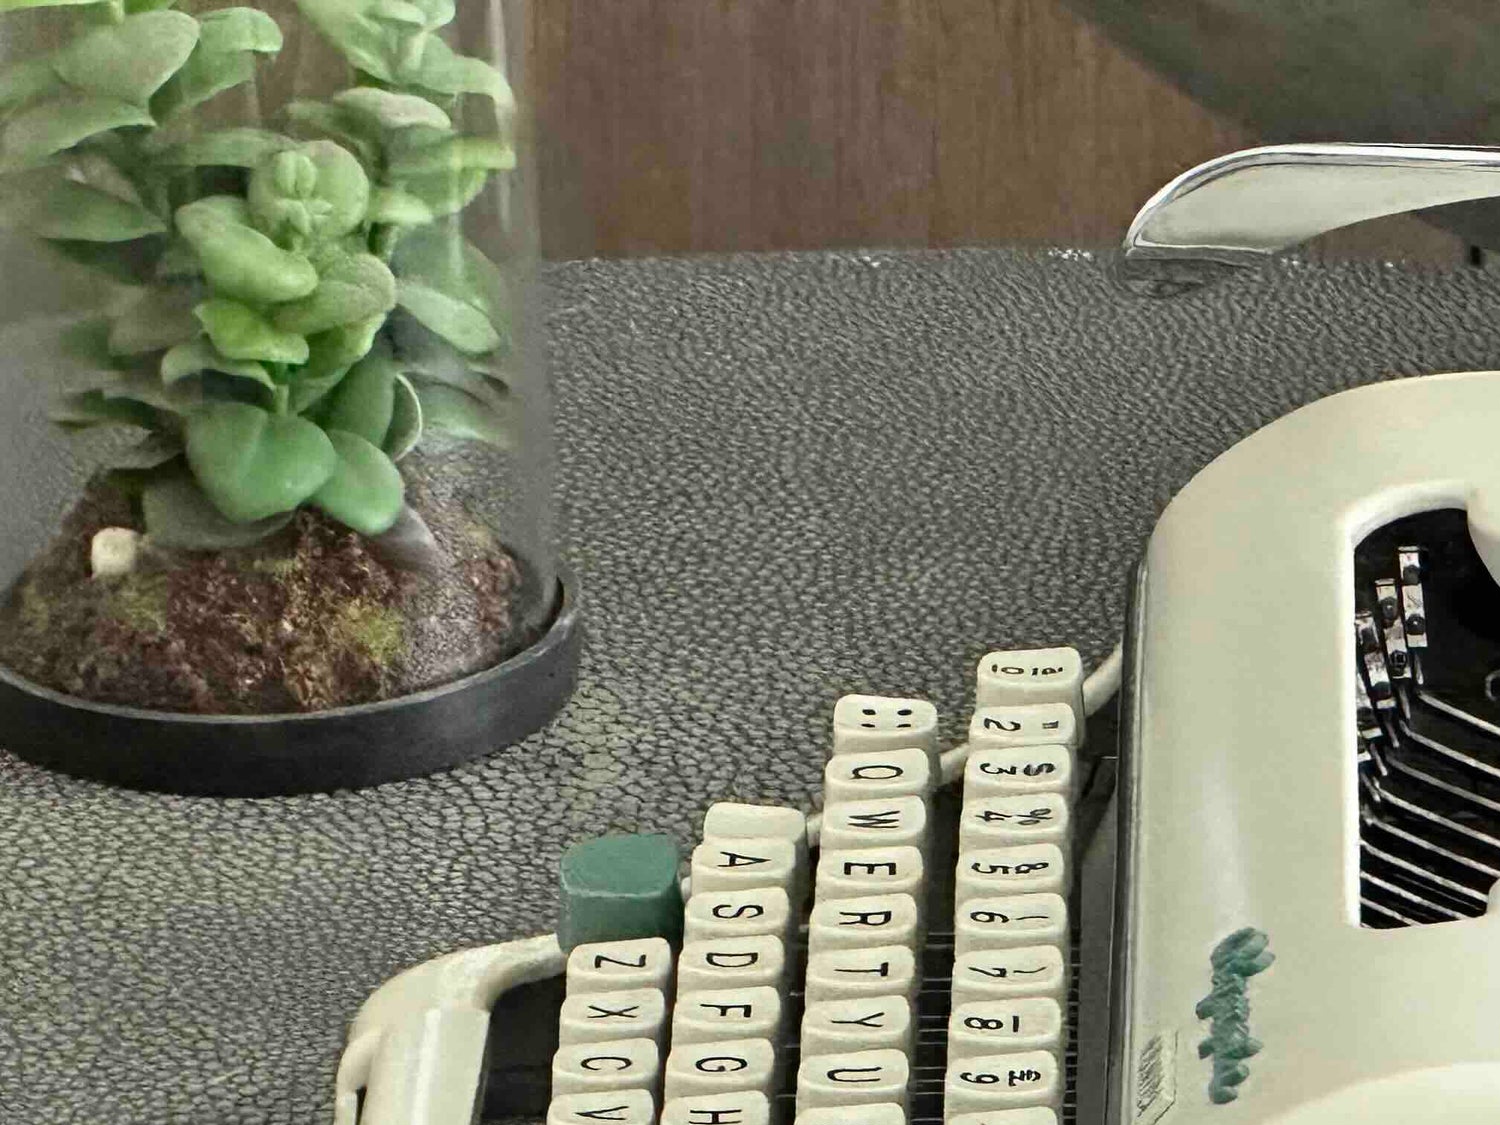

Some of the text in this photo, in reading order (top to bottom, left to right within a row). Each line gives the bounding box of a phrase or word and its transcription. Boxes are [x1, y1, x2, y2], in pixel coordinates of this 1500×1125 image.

[983, 717, 1022, 732] 2
[850, 764, 904, 780] Q
[979, 762, 1018, 776] 3
[847, 810, 901, 829] W
[975, 810, 1011, 823] 4
[717, 851, 771, 868] A
[843, 861, 897, 876] E
[971, 862, 1013, 875] 5
[712, 904, 765, 920] S
[838, 910, 892, 927] R
[969, 911, 1010, 924] 6
[594, 954, 647, 969] Z
[705, 952, 759, 968] D
[834, 961, 890, 978] T
[968, 966, 1008, 979] 7
[587, 1005, 640, 1019] X
[699, 1003, 752, 1019] F
[830, 1011, 885, 1028] Y
[963, 1016, 1004, 1031] 8
[580, 1056, 633, 1071] C
[694, 1056, 748, 1073] G
[826, 1066, 883, 1083] U
[959, 1072, 1000, 1085] 9
[575, 1105, 630, 1121] V
[688, 1109, 743, 1125] H
